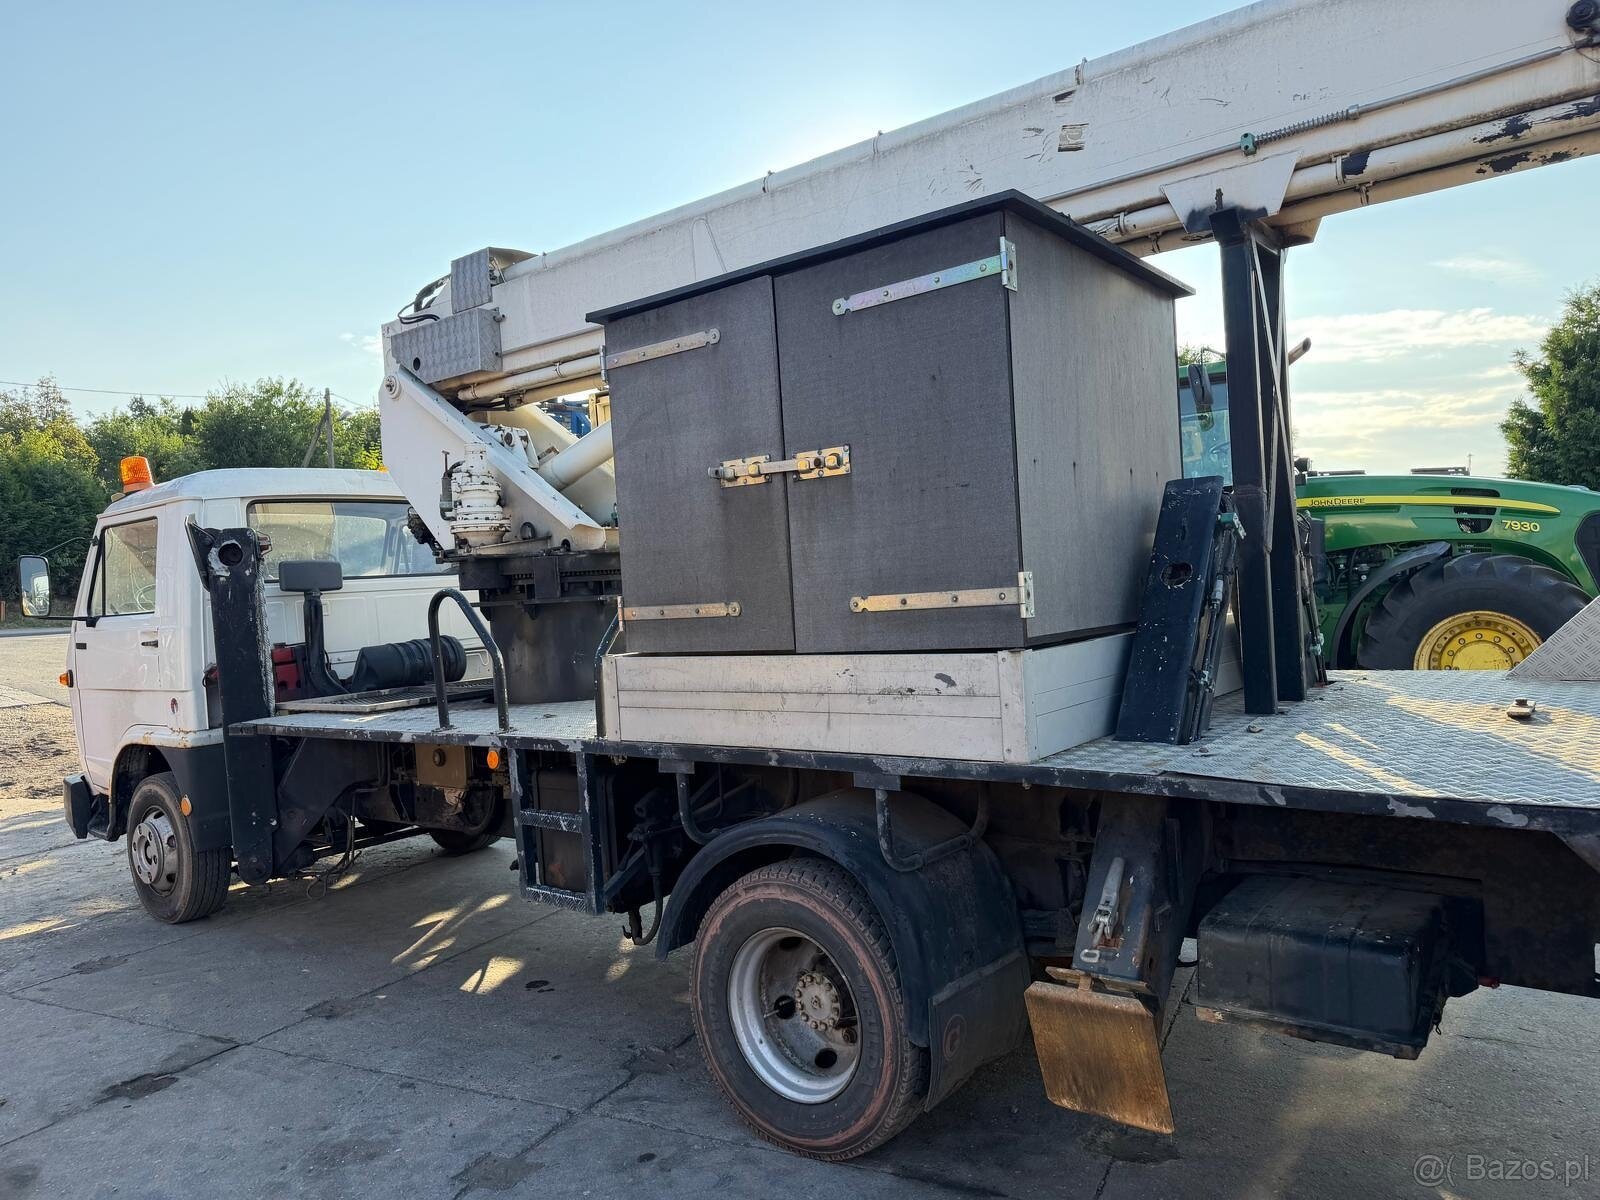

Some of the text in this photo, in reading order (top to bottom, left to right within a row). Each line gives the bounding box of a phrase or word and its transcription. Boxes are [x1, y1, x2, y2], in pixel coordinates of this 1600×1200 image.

[1310, 497, 1366, 506] JOHN DEERE
[1501, 519, 1541, 532] 7930
